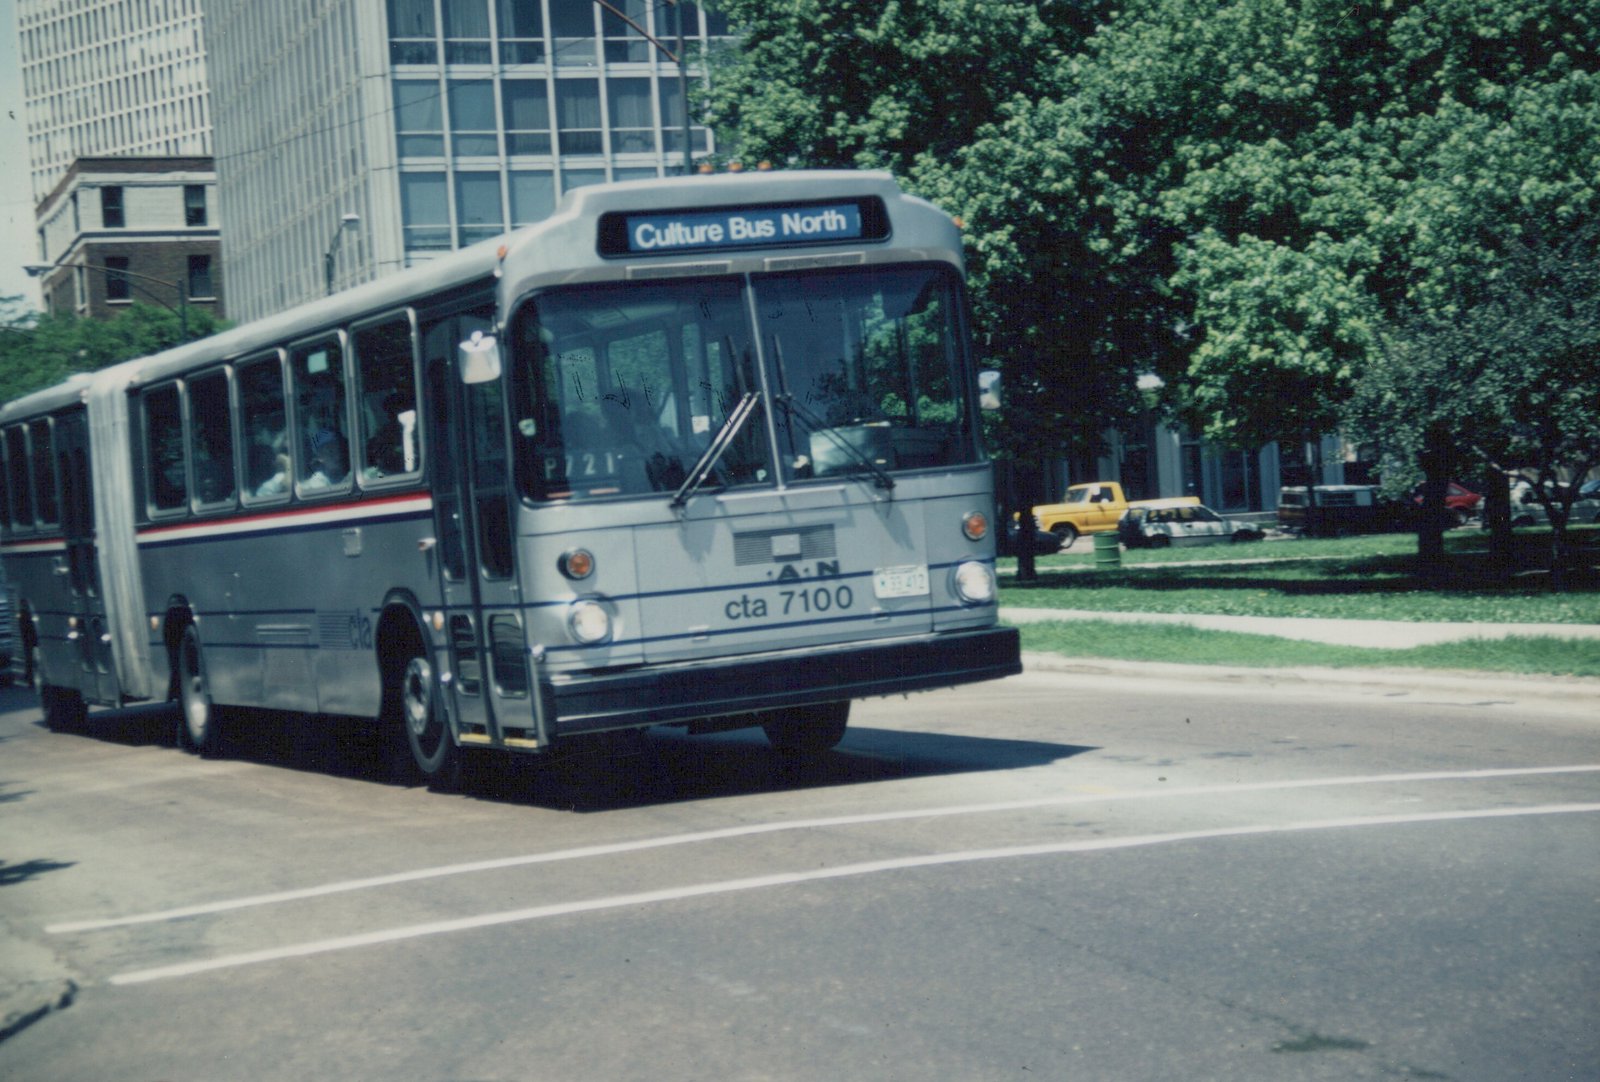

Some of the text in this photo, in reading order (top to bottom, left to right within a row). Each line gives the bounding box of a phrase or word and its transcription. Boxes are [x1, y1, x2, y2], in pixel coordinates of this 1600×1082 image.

[635, 210, 846, 248] Culture Bus North
[724, 585, 853, 620] cta 7100
